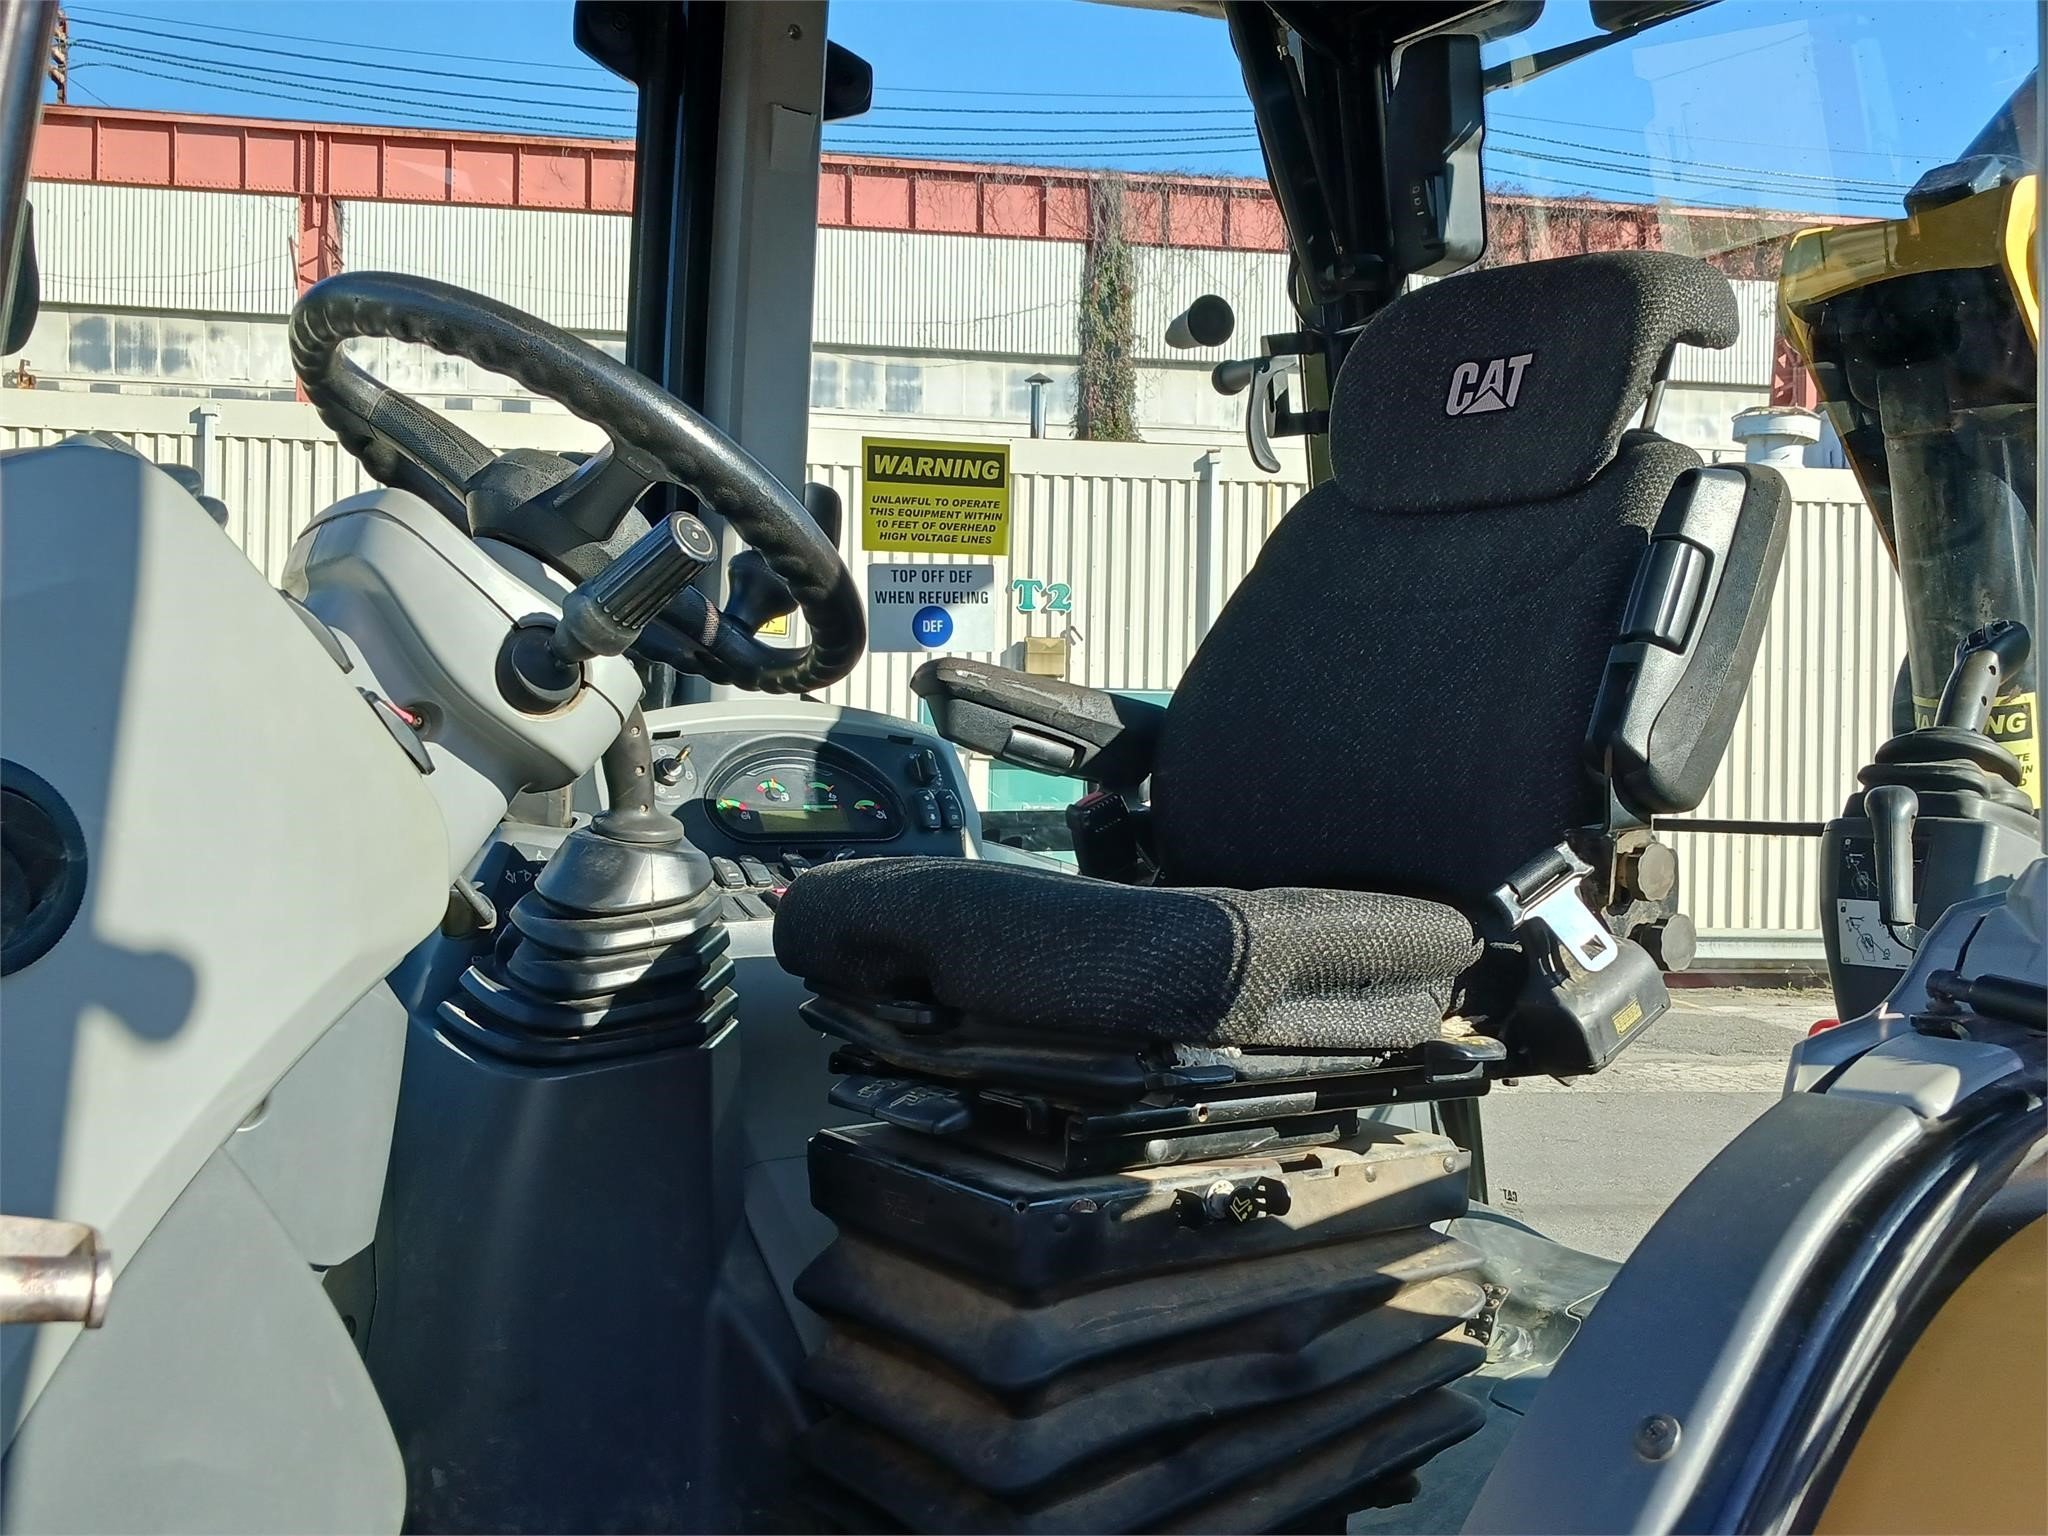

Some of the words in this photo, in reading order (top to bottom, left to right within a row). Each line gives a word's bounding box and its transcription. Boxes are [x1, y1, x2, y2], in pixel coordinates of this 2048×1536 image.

[1446, 353, 1534, 416] CAT
[874, 454, 1000, 479] WARNING
[871, 495, 931, 506] UNLAWFUL
[935, 497, 949, 507] TO
[951, 498, 1001, 509] OPERATE
[869, 507, 895, 517] THIS
[897, 509, 961, 520] EQUIPMENT
[964, 511, 1003, 521] WITHIN
[875, 519, 889, 528] 10
[891, 520, 919, 529] FEET
[921, 521, 937, 530] OF
[939, 522, 997, 533] OVERHEAD
[879, 532, 907, 542] HIGH
[910, 533, 958, 543] VOLTAGE
[961, 535, 992, 545] LINES
[890, 569, 917, 583] TOP
[921, 569, 945, 583] OFF
[949, 570, 973, 584] DEF
[874, 590, 914, 605] WHEN
[919, 591, 989, 605] REFUELING
[922, 619, 944, 633] DEF
